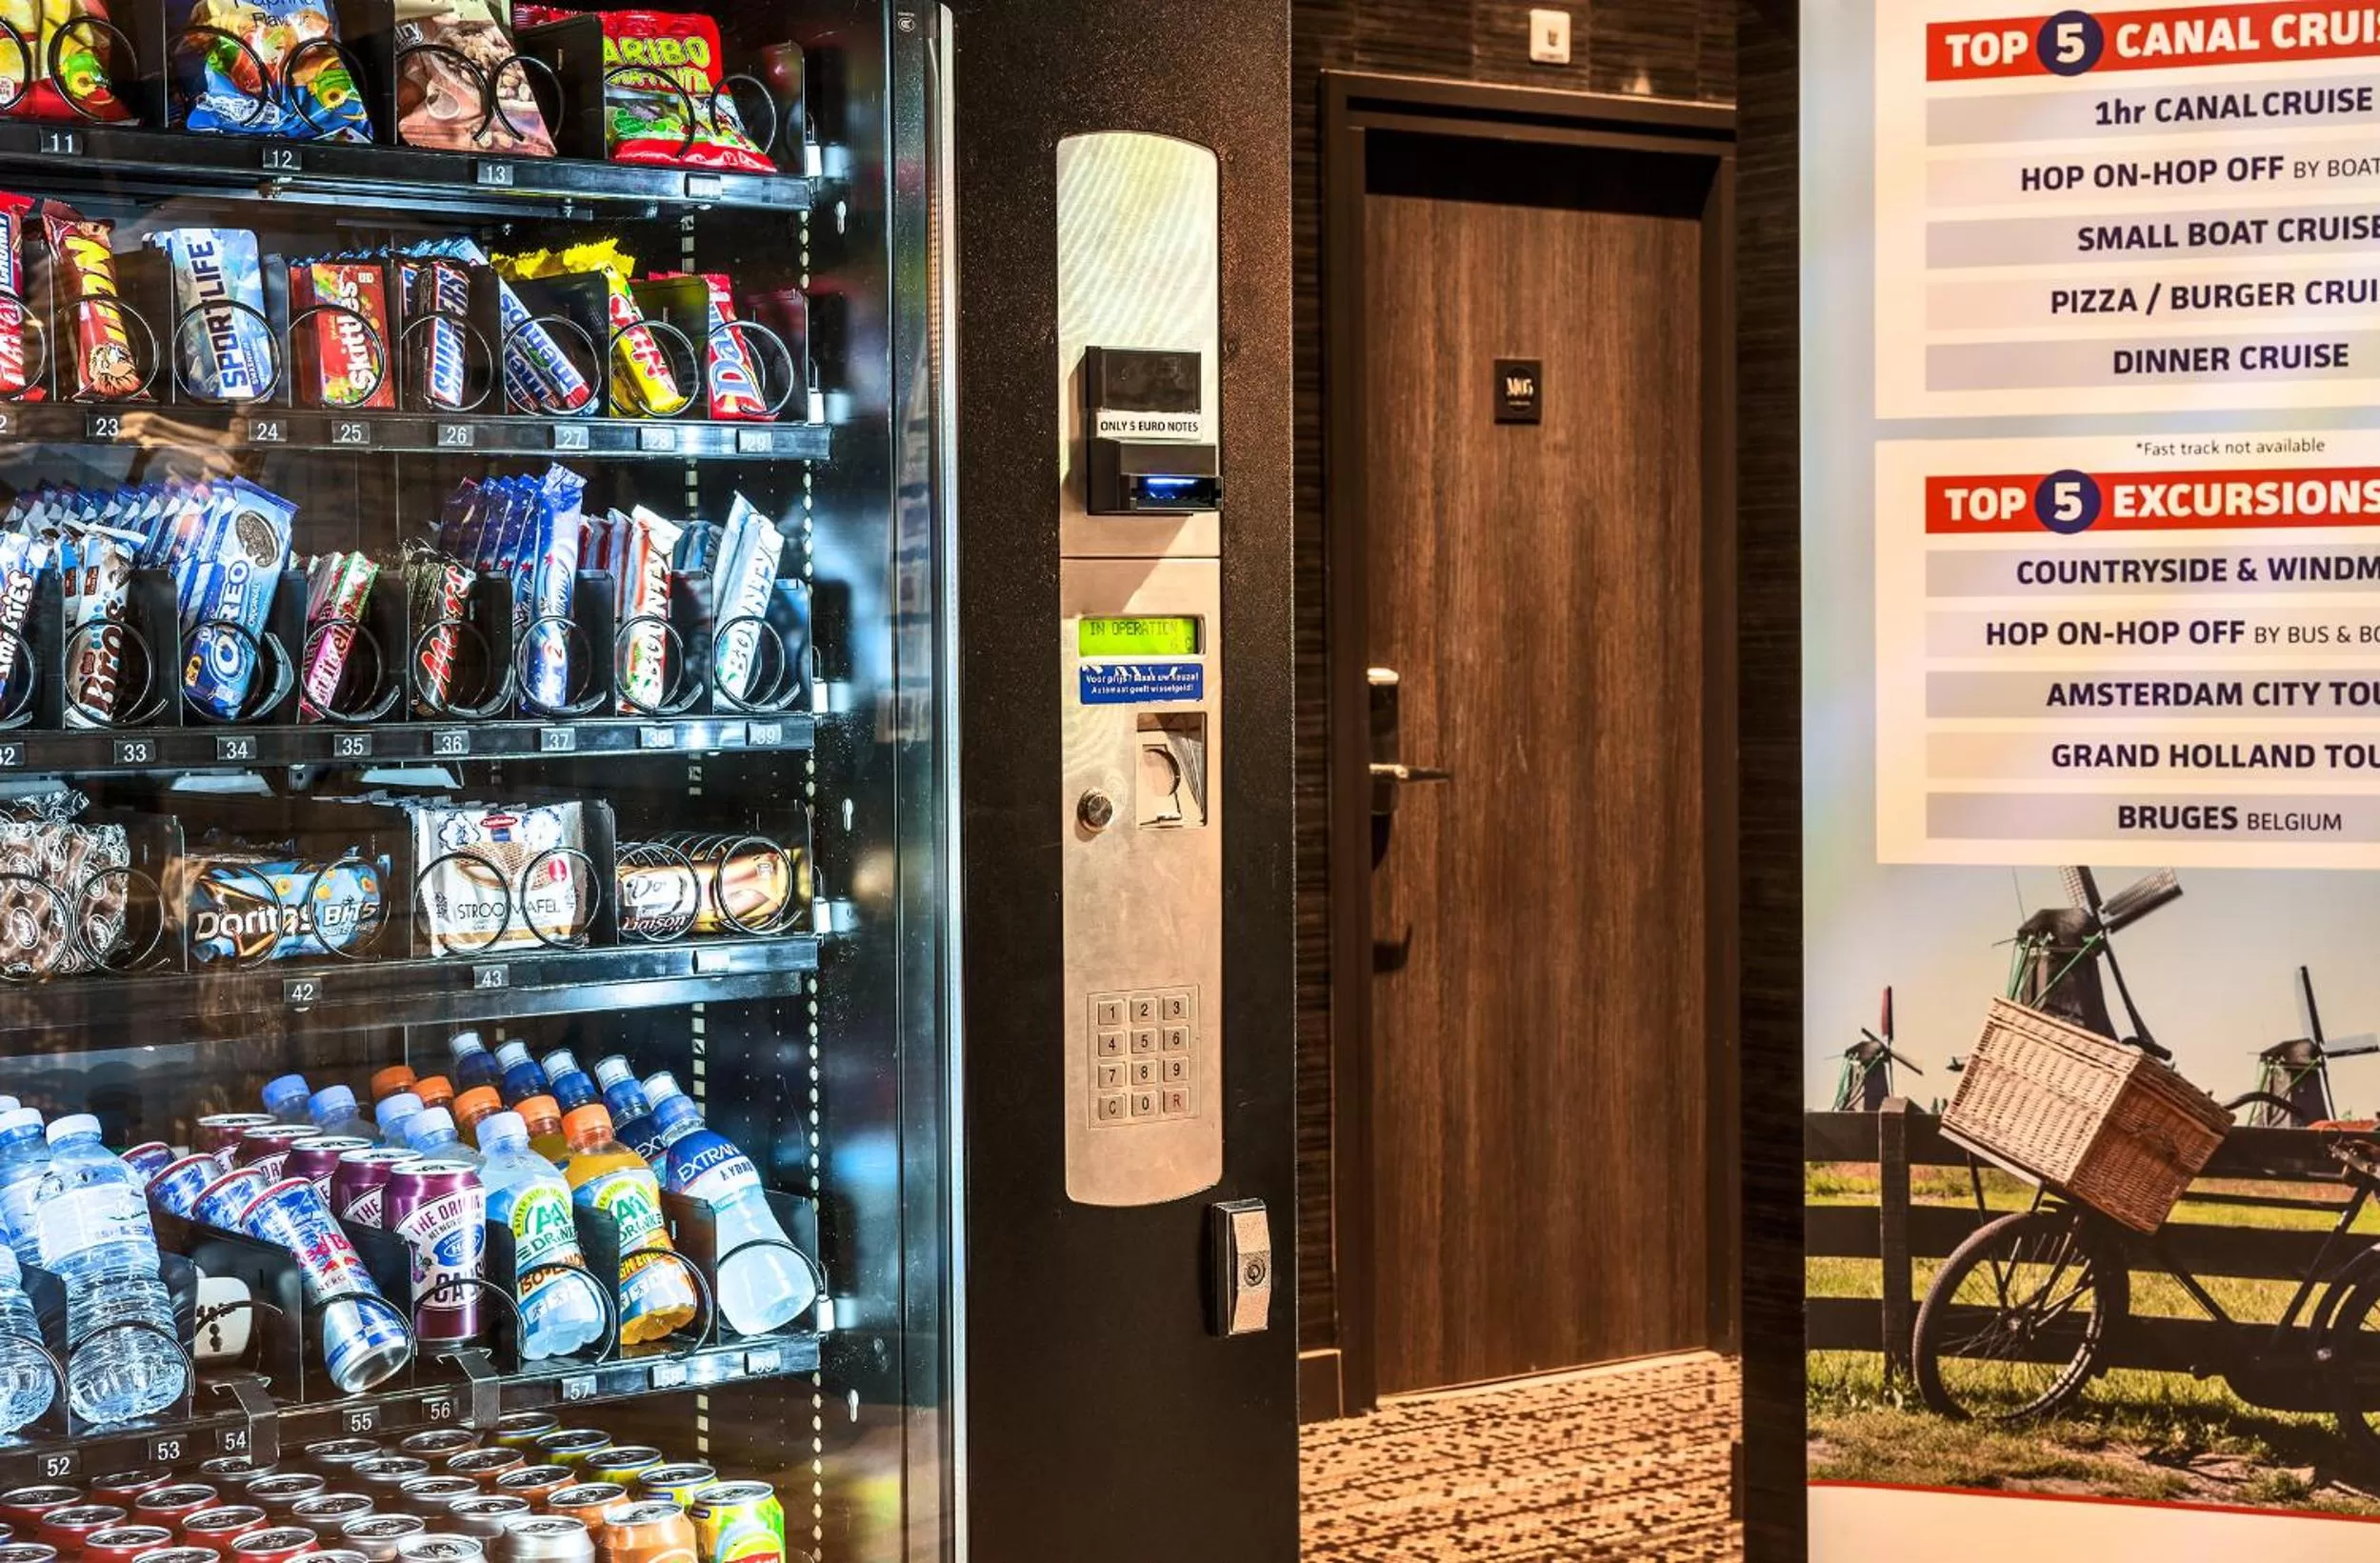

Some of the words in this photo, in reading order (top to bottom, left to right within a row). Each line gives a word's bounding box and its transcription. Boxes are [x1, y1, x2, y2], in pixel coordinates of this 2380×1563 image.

[1945, 32, 2029, 68] TOP
[2055, 23, 2086, 65] 5
[2116, 16, 2260, 58] CANAL
[2270, 9, 2380, 50] CRUI
[603, 36, 710, 69] ARIBO
[2094, 98, 2146, 127] 1hr
[2155, 93, 2258, 123] CANAL
[2263, 88, 2373, 117] CRUISE
[50, 132, 73, 153] 11
[271, 150, 292, 169] 12
[486, 166, 506, 183] 13
[2021, 166, 2085, 191] HOP
[2093, 159, 2218, 188] ON-HOP
[2227, 156, 2284, 182] OFF
[2292, 160, 2320, 179] BY
[2327, 157, 2380, 178] BOAT
[2077, 222, 2179, 252] SMALL
[2188, 219, 2269, 248] BOAT
[2276, 214, 2380, 243] CRUISE
[2050, 288, 2138, 314] PIZZA
[2146, 282, 2162, 315] /
[2170, 282, 2295, 311] BURGER
[2305, 278, 2379, 306] CRUI
[188, 240, 250, 389] SPORTLIFE
[2112, 347, 2230, 375] DINNER
[2239, 343, 2350, 371] CRUISE
[96, 419, 118, 436] 23
[256, 423, 278, 441] 24
[341, 425, 362, 442] 25
[446, 428, 468, 445] 26
[1100, 421, 1127, 432] ONLY
[1130, 421, 1135, 431] 5
[1138, 421, 1166, 431] EURO
[1168, 421, 1199, 432] NOTES
[563, 430, 581, 447] 27
[2180, 439, 2220, 455] track
[2225, 441, 2250, 454] not
[2256, 437, 2326, 454] available
[1944, 487, 2028, 521] TOP
[2052, 482, 2084, 523] 5
[2112, 480, 2380, 519] EXCURSIONS
[2016, 557, 2228, 585] COUNTRYSIDE
[2236, 557, 2258, 583] &
[2268, 555, 2380, 582] WINDM
[214, 559, 250, 677] OREO
[1090, 622, 1106, 635] IN
[1112, 621, 1179, 636] OPERATION
[1986, 622, 2049, 647] HOP
[2057, 619, 2180, 646] ON-HOP
[2189, 619, 2246, 644] OFF
[2254, 626, 2280, 645] BY
[2288, 626, 2330, 644] BUS
[2336, 625, 2352, 643] &
[2046, 681, 2243, 708] AMSTERDAM
[2251, 681, 2322, 707] CITY
[226, 741, 248, 759] 34
[342, 738, 364, 755] 35
[441, 736, 463, 753] 36
[549, 733, 569, 750] 37
[124, 746, 147, 763] 33
[2050, 743, 2160, 770] GRAND
[2169, 743, 2315, 769] HOLLAND
[2324, 742, 2380, 768] TOU
[2117, 804, 2238, 831] BRUGES
[2247, 812, 2343, 832] BELGIUM
[456, 898, 561, 920] STROOWAFEL
[194, 904, 312, 941] Doritos
[481, 969, 502, 988] 43
[290, 983, 313, 1001] 42
[1141, 1003, 1149, 1016] 2
[1173, 1001, 1180, 1014] 3
[1109, 1036, 1116, 1051] 4
[1141, 1034, 1149, 1048] 5
[1172, 1032, 1180, 1045] 6
[1109, 1069, 1116, 1083] 7
[1141, 1066, 1149, 1079] 8
[1173, 1063, 1180, 1076] 9
[1109, 1100, 1116, 1114] C
[1172, 1094, 1181, 1107] R
[677, 1143, 741, 1182] EXTRAN
[354, 1198, 381, 1223] THE
[536, 1202, 569, 1234] AA
[408, 1211, 437, 1236] THE
[570, 1380, 590, 1399] 57
[430, 1402, 451, 1421] 56
[350, 1413, 373, 1433] 55
[157, 1441, 181, 1461] 53
[225, 1430, 247, 1452] 54
[47, 1456, 71, 1478] 52
